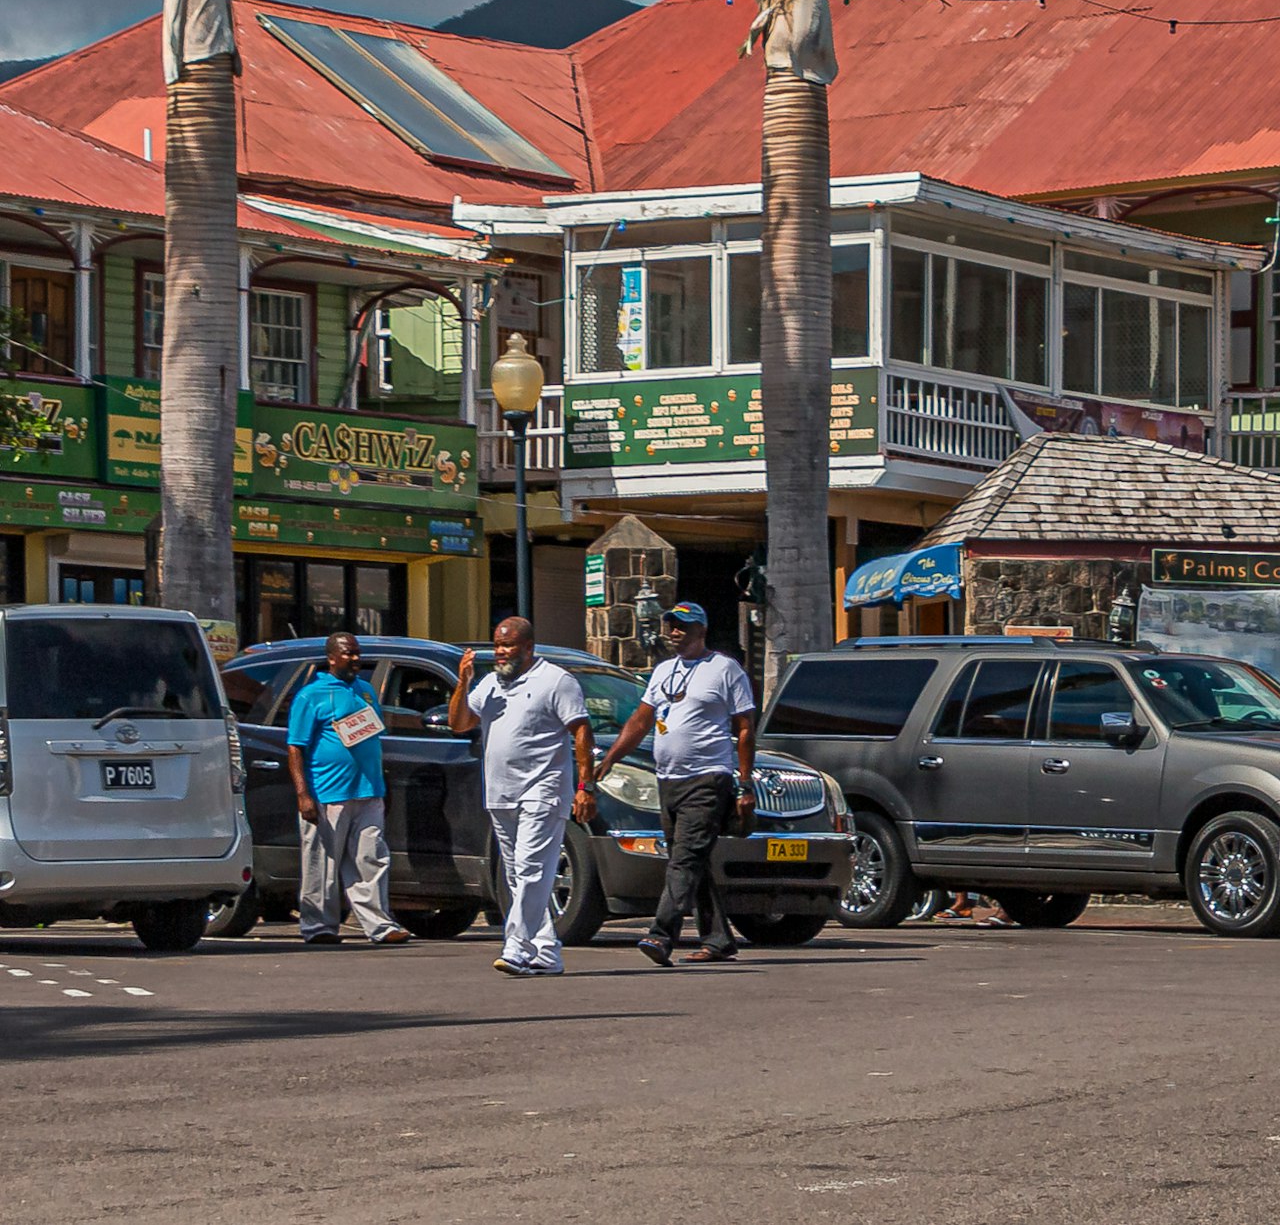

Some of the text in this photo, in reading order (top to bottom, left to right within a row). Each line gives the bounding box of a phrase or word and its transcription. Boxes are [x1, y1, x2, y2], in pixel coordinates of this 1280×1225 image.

[1182, 559, 1247, 577] Palms
[106, 766, 153, 785] P 7605
[770, 843, 787, 857] TA
